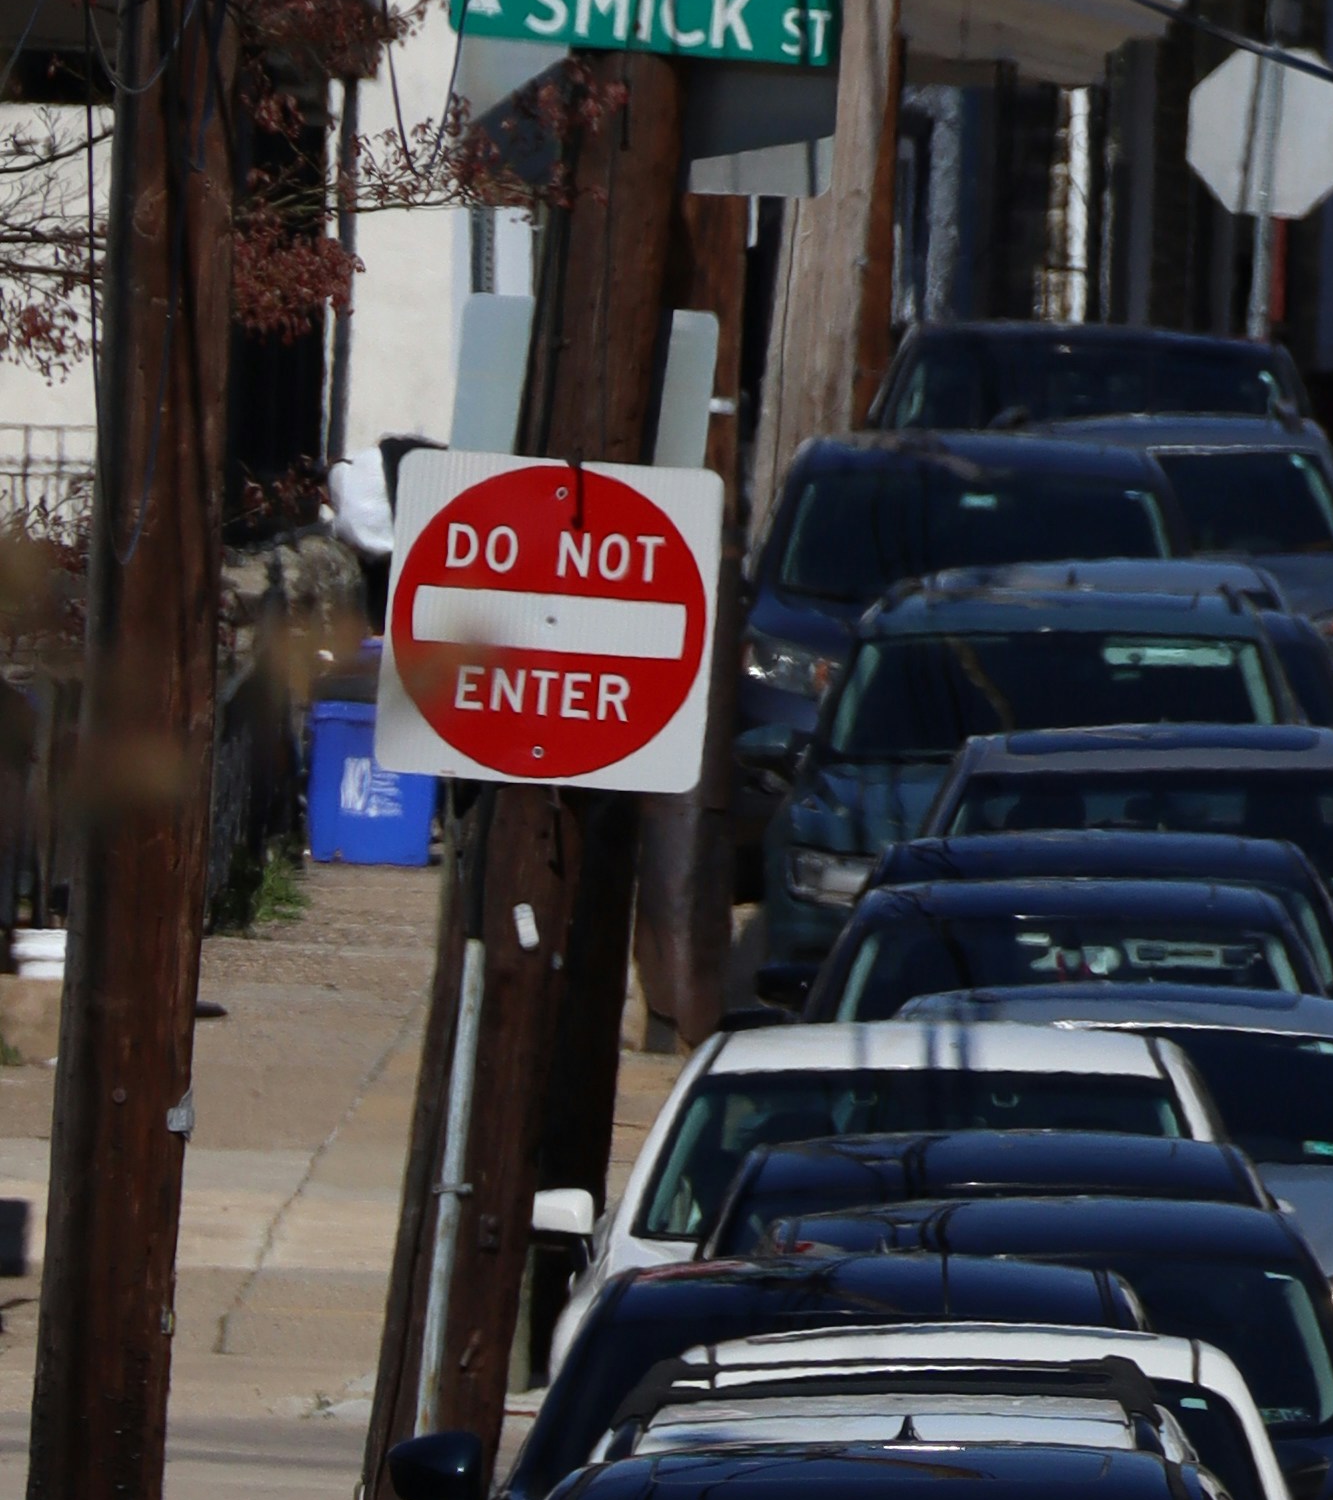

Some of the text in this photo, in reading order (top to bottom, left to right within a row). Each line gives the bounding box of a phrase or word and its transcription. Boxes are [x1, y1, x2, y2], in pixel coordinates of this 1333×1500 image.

[780, 6, 833, 58] ST
[445, 522, 667, 583] DO NOT
[454, 665, 632, 723] ENTER
